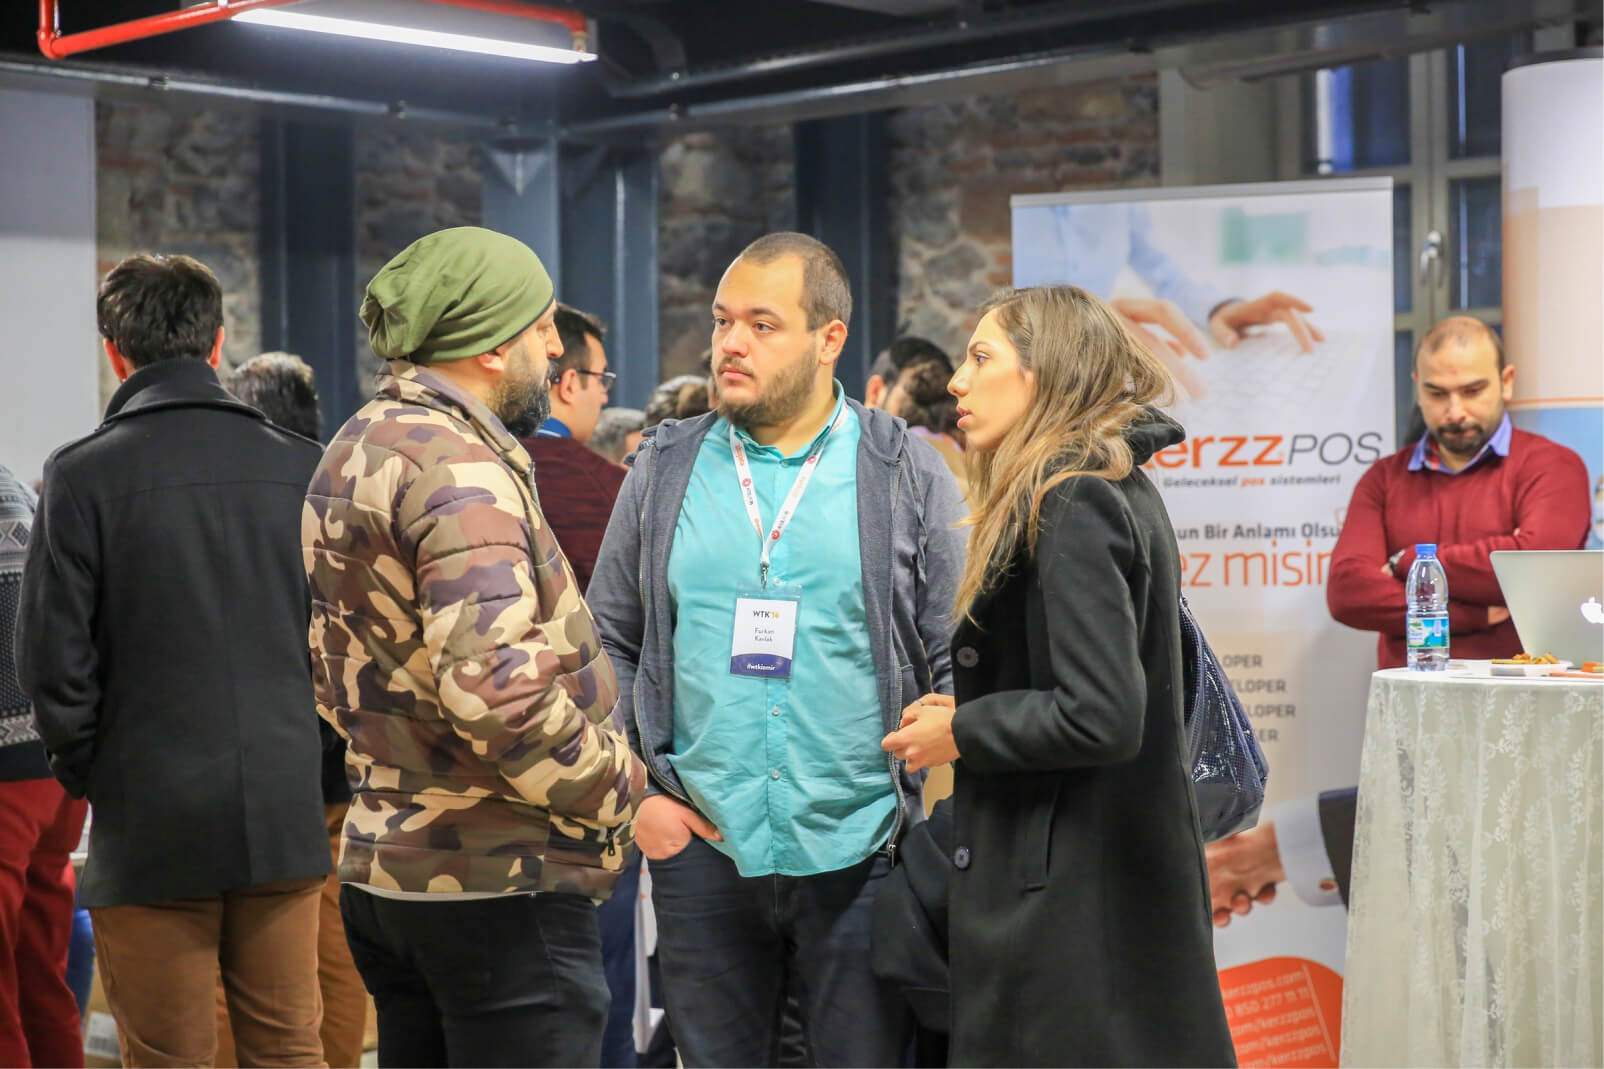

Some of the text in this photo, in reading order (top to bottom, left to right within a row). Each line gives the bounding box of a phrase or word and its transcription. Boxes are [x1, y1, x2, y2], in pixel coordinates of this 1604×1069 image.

[1241, 477, 1265, 488] pos
[1270, 474, 1341, 486] sistemleri
[1177, 522, 1341, 540] un Bir Anlamı Olsu
[1222, 655, 1262, 667] OPER
[1235, 680, 1286, 693] LOPER
[1246, 704, 1296, 717] LOPER
